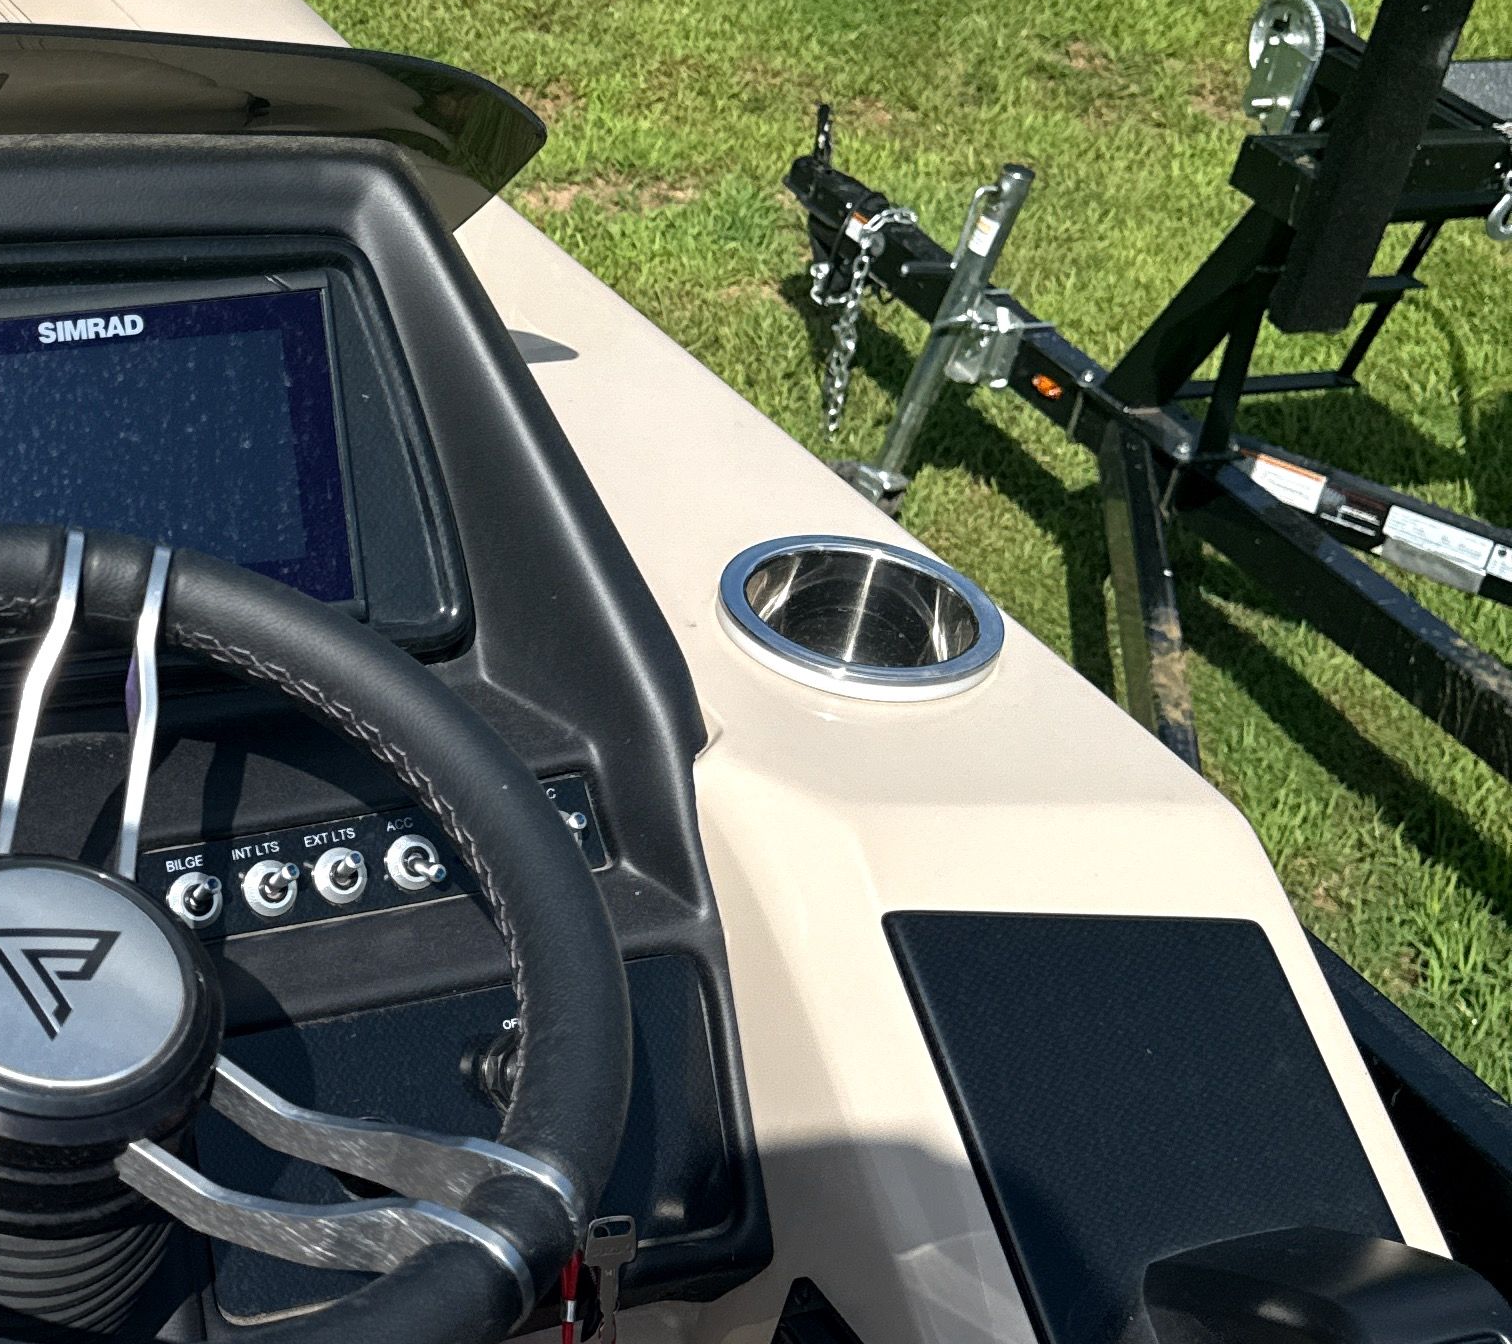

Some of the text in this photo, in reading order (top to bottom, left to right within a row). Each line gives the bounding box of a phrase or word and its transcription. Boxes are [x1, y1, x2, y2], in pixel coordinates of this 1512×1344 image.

[38, 314, 145, 344] SIMRAD
[386, 817, 414, 832] ACC
[304, 827, 356, 848] EXT LTS
[231, 841, 280, 861] INT LTS
[166, 854, 204, 873] BILGE
[502, 1017, 519, 1030] OF
